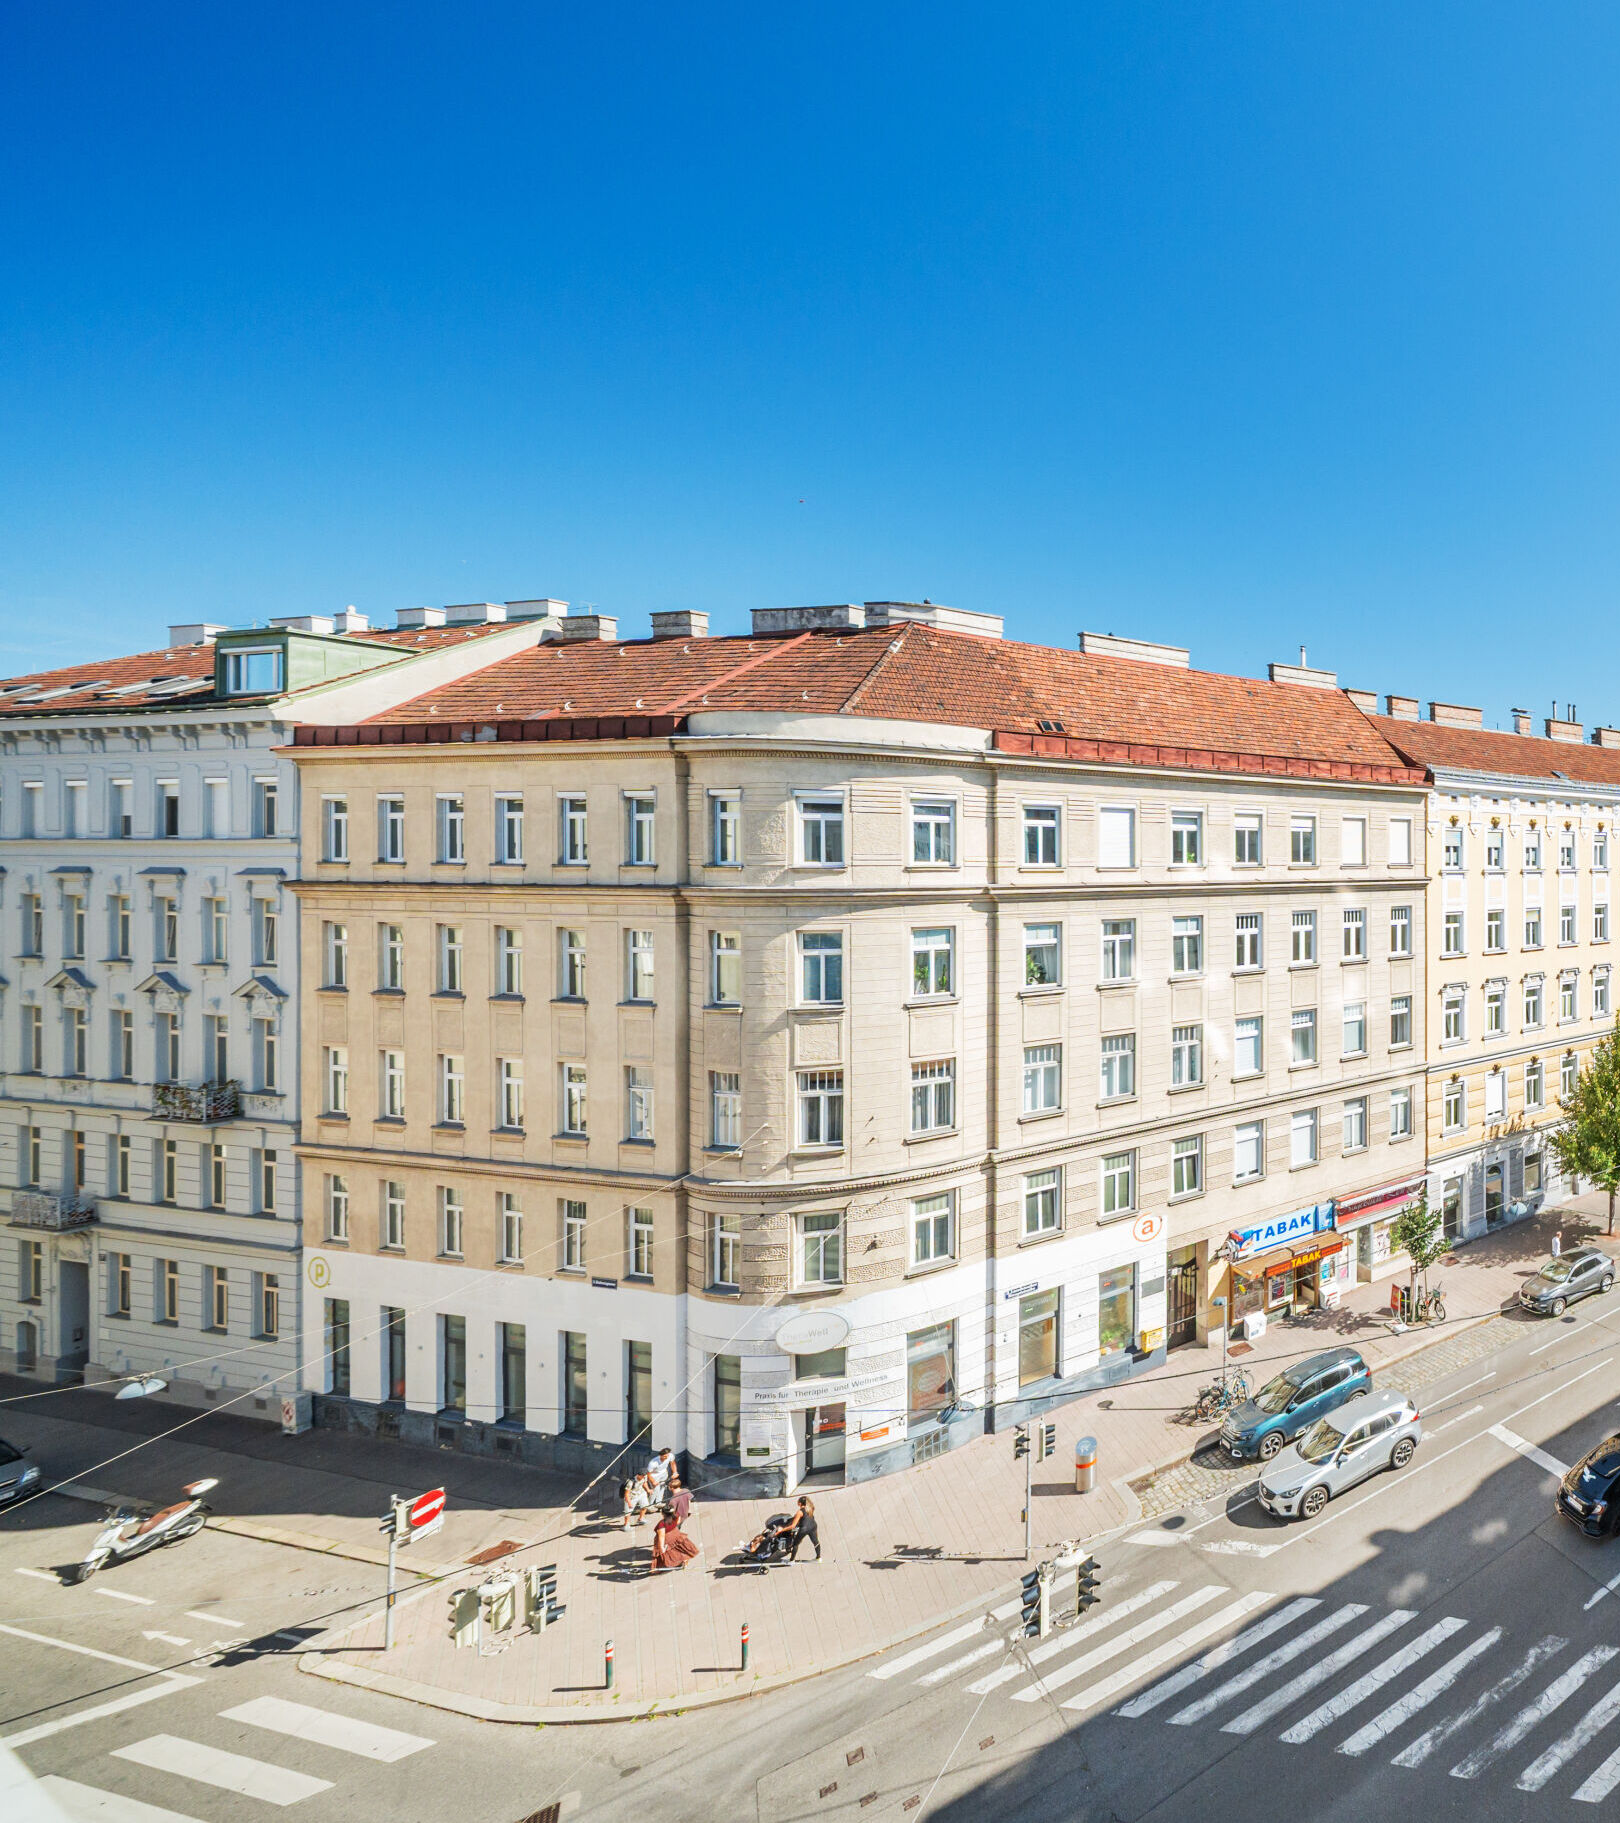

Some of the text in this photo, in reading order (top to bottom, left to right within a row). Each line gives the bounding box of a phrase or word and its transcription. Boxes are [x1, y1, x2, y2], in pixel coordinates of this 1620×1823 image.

[1253, 1214, 1312, 1241] TABAK
[1291, 1250, 1321, 1268] TABAK
[754, 1392, 777, 1400] Praxis
[794, 1387, 829, 1398] Therapie
[833, 1383, 849, 1392] und
[851, 1374, 888, 1388] Wellness
